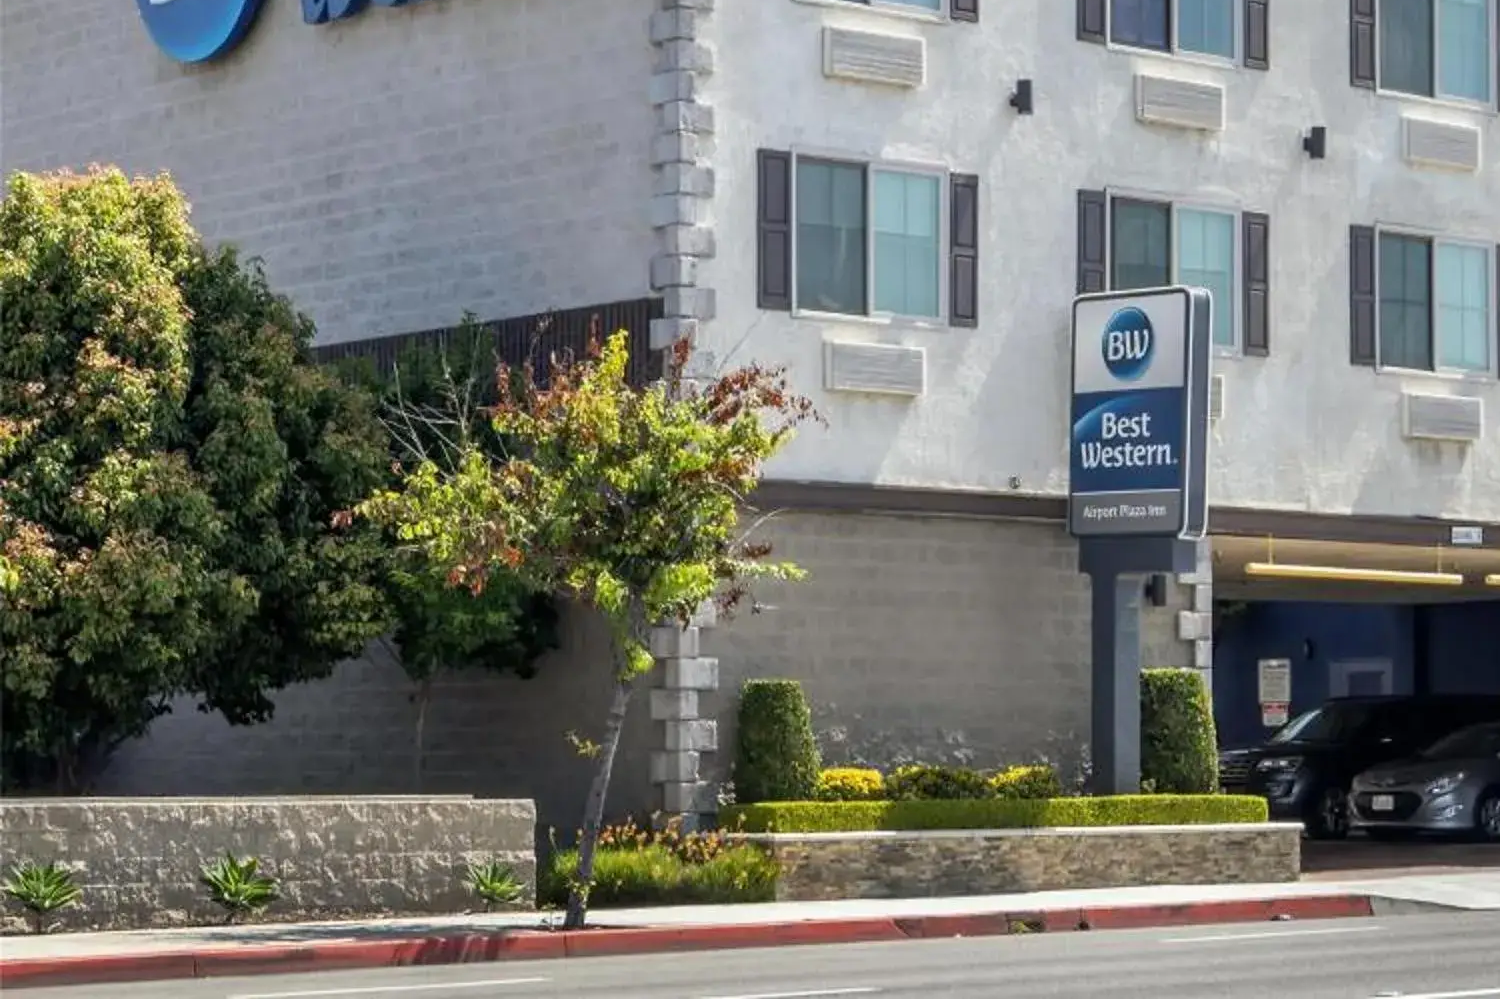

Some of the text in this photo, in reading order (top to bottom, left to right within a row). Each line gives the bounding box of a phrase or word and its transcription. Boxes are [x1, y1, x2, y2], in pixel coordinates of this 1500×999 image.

[1107, 328, 1150, 361] BW
[1101, 412, 1151, 439] Best
[1083, 504, 1118, 521] Airport
[1119, 504, 1147, 518] Plaza
